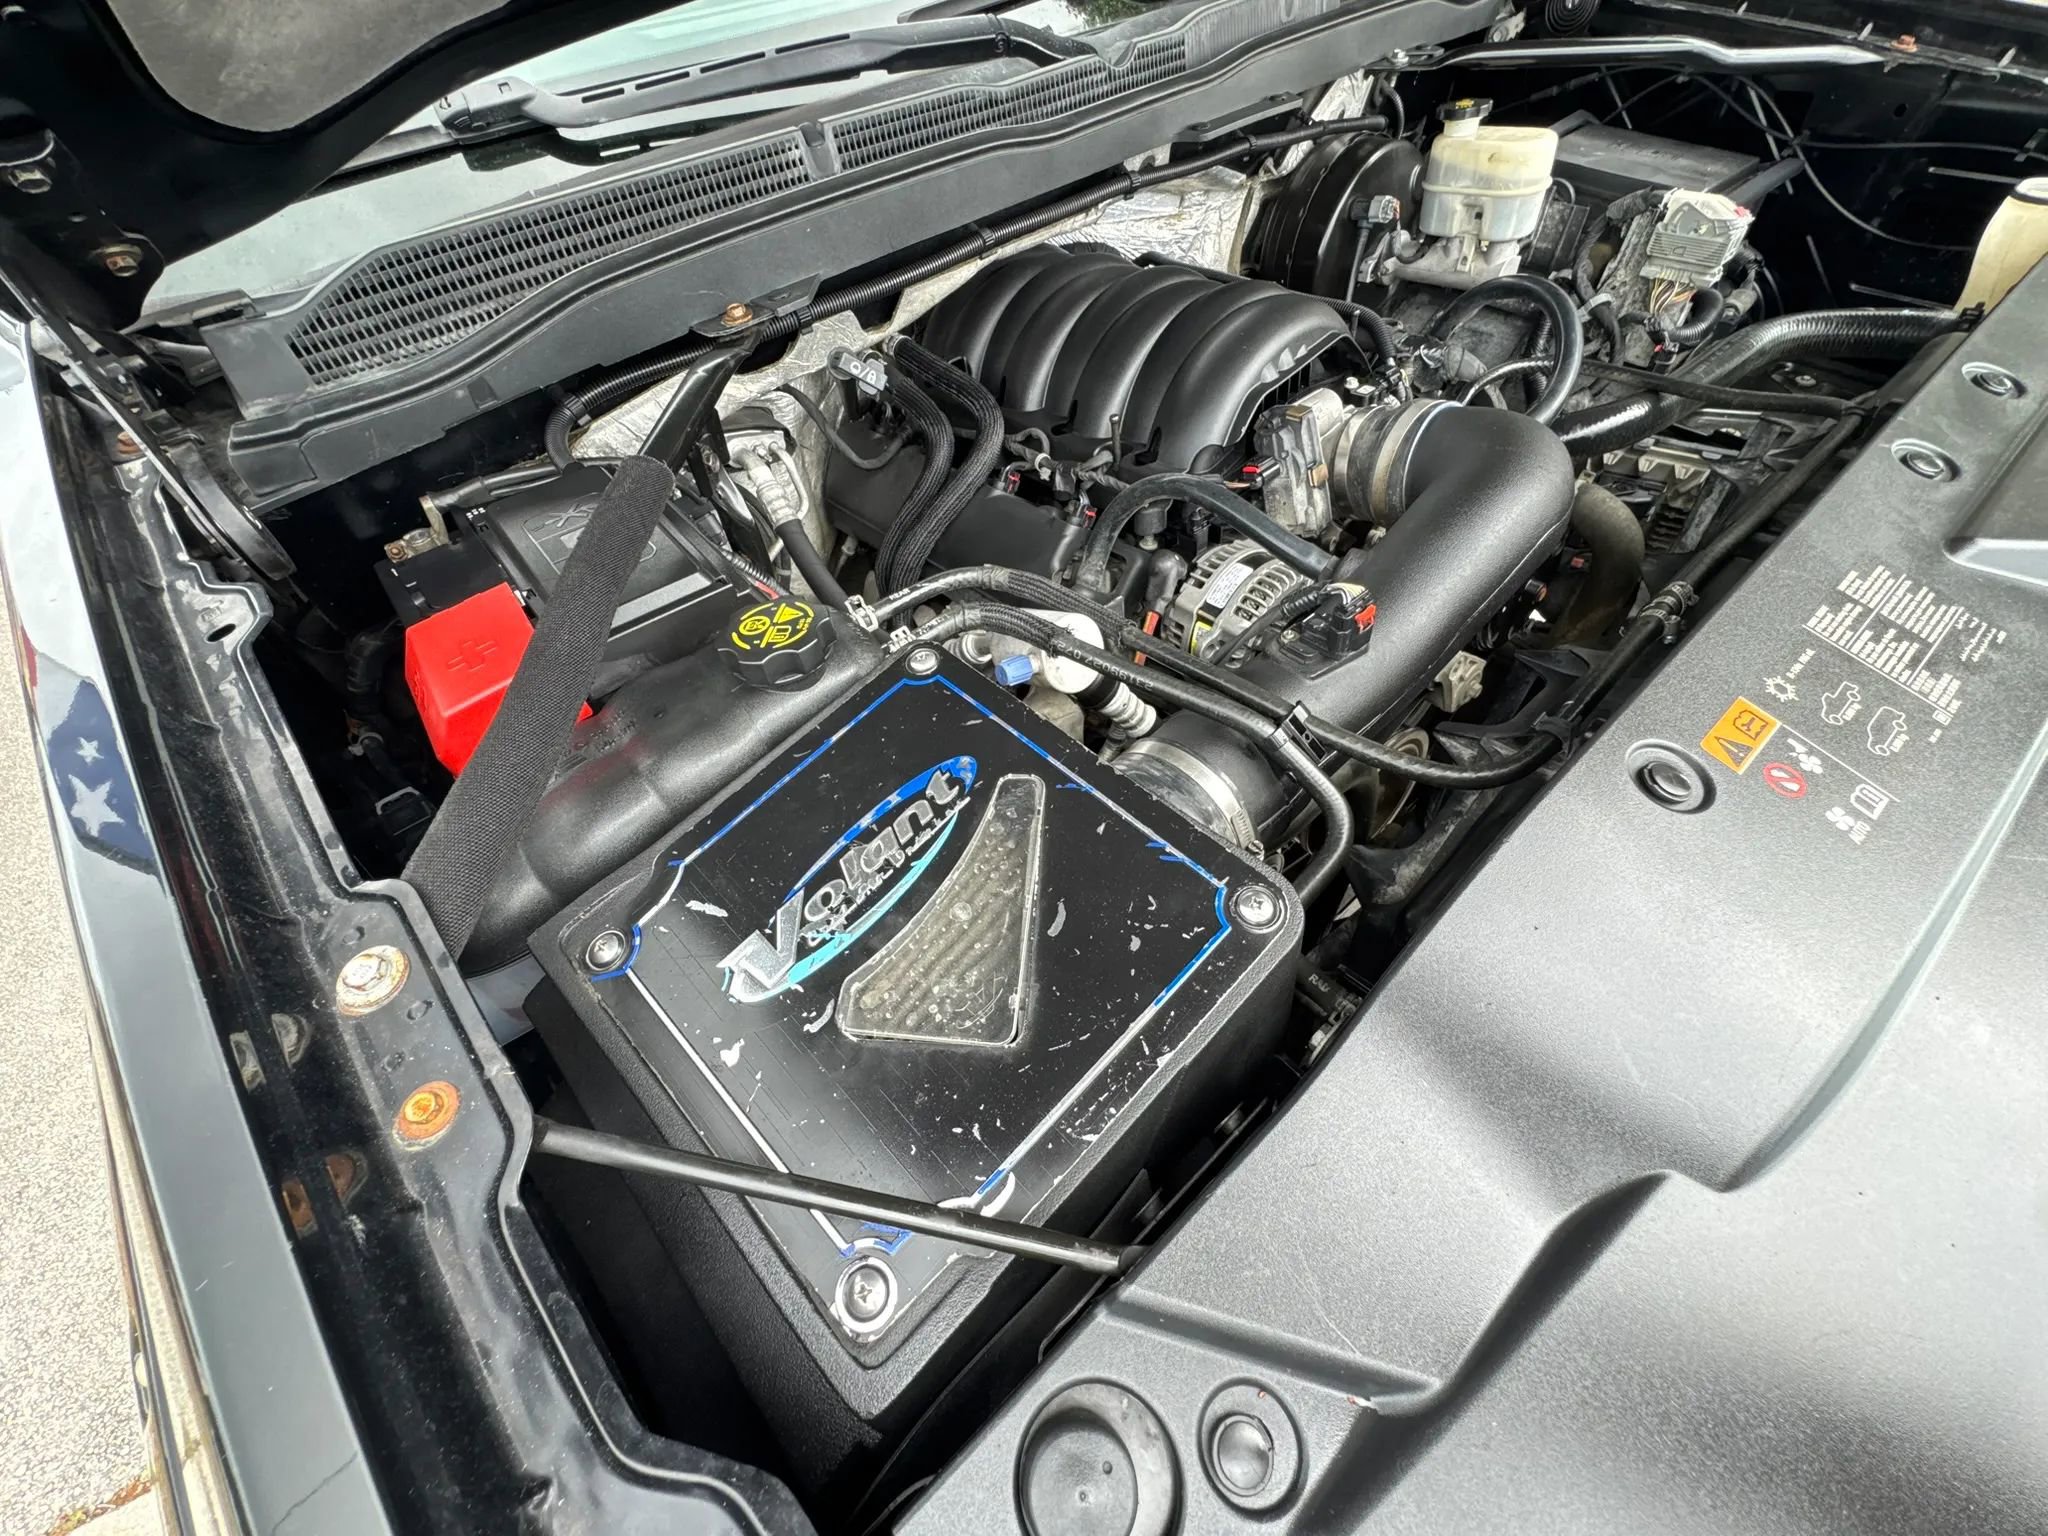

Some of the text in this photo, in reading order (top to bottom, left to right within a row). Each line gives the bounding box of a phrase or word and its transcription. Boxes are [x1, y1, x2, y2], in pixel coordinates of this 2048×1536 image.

[889, 588, 911, 601] REAR
[1848, 820, 1872, 845] AUTO
[715, 769, 960, 990] Volant
